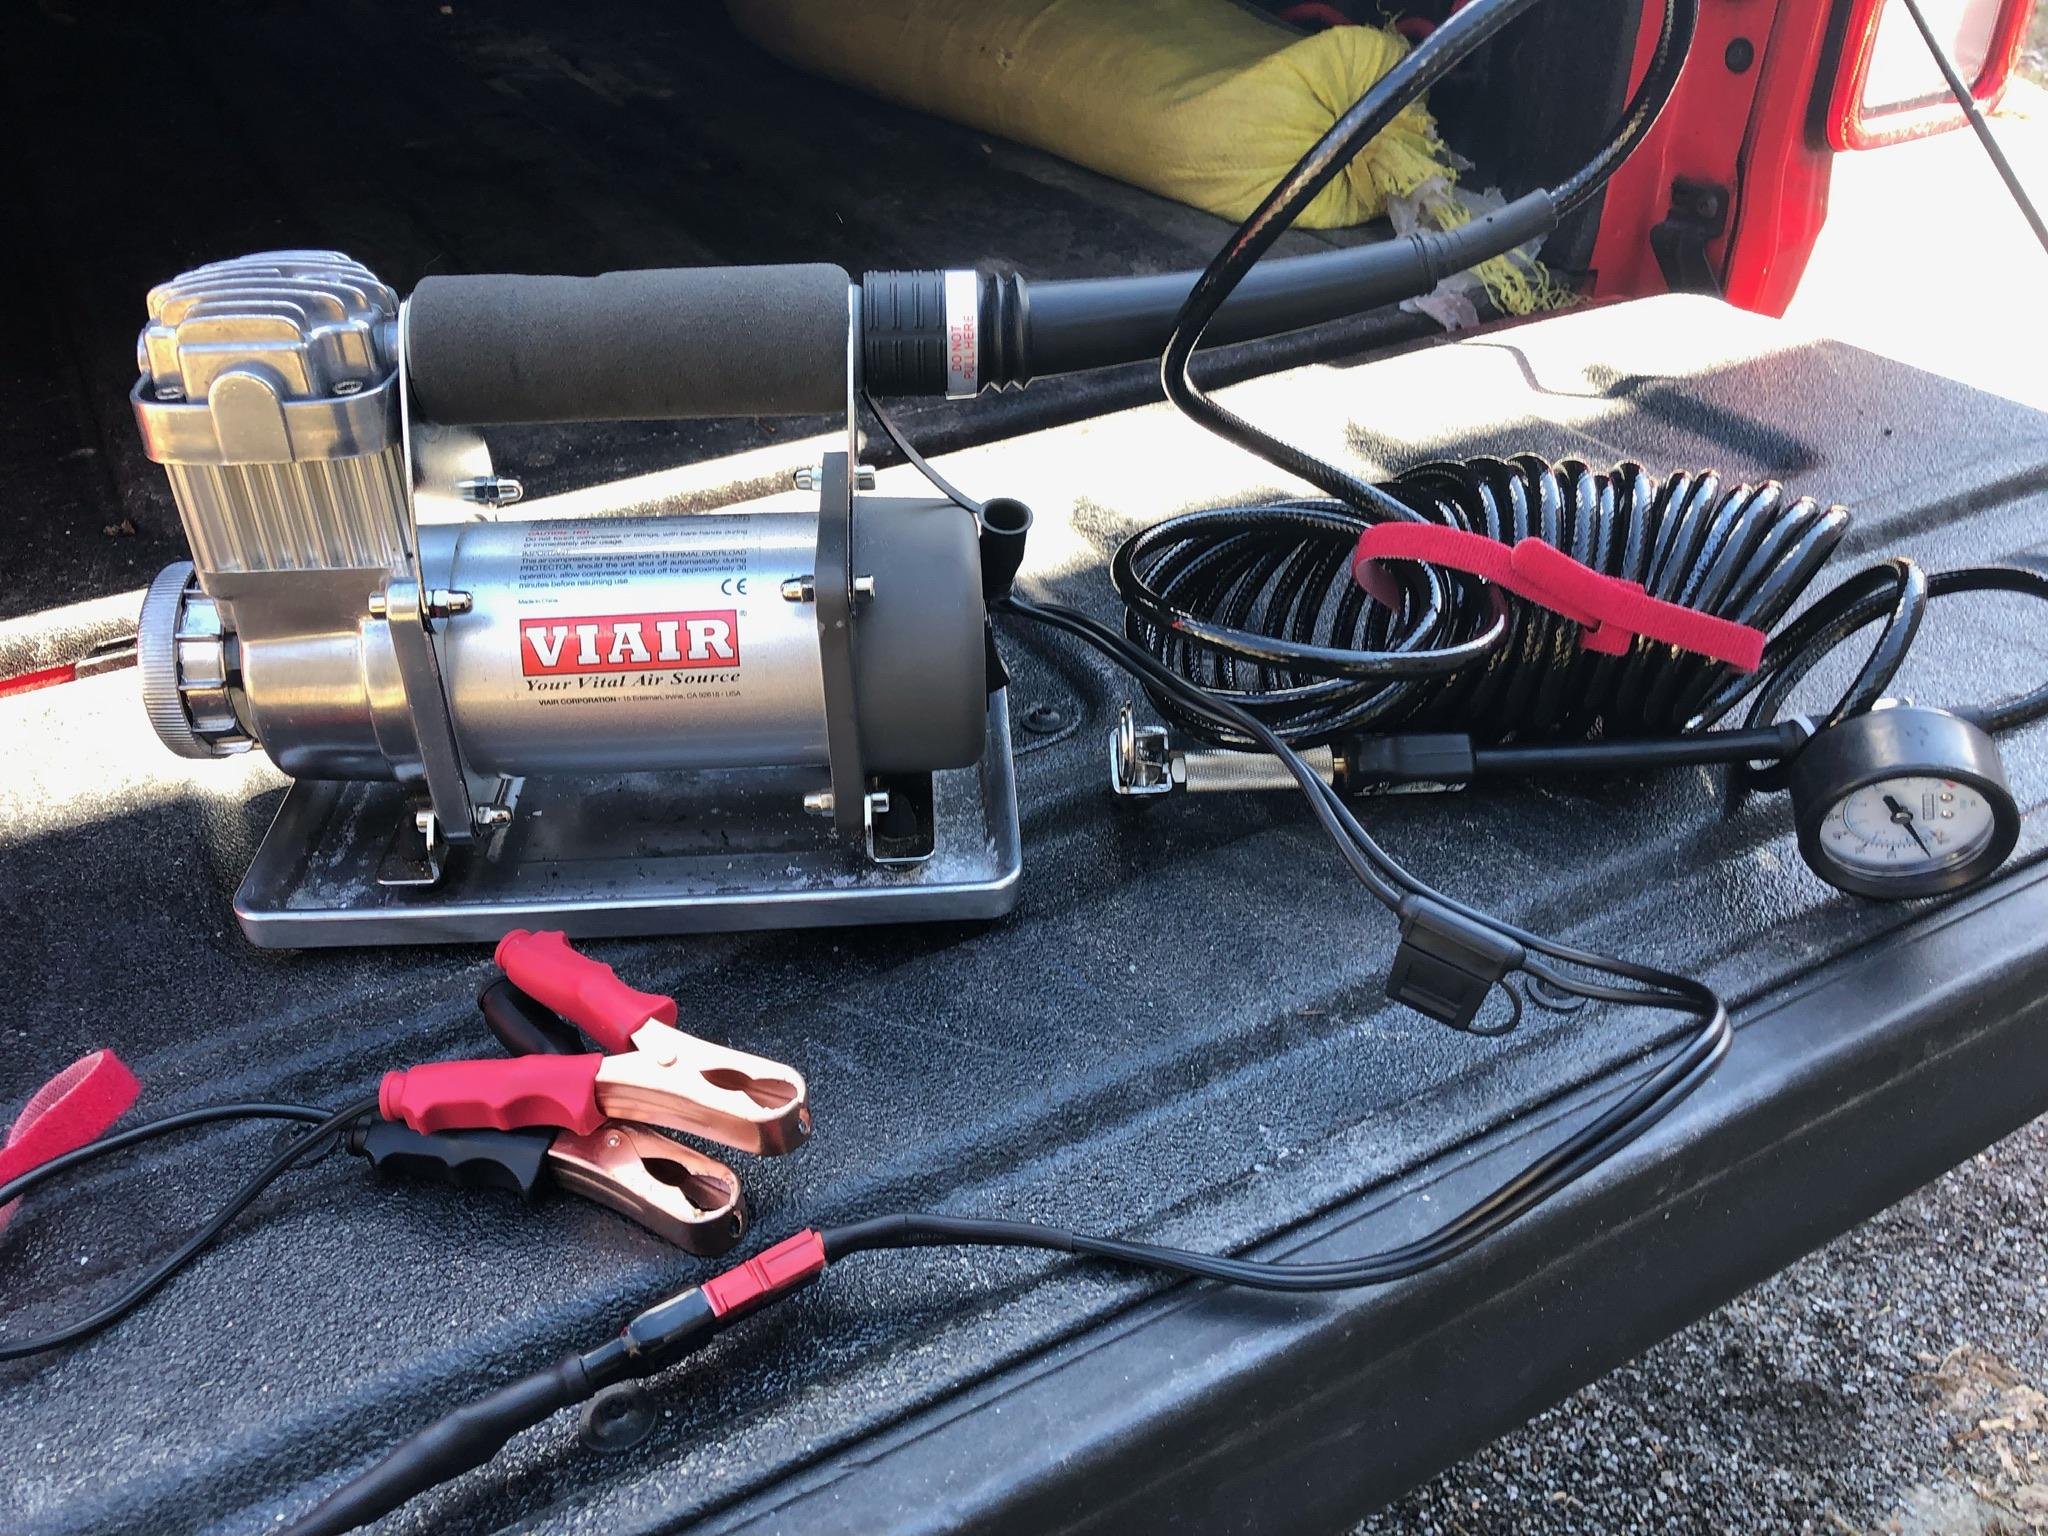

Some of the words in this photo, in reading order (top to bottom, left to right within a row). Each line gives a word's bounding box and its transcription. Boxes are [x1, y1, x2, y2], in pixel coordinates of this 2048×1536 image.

[951, 325, 961, 352] NOT
[964, 316, 974, 349] HERE
[952, 355, 961, 371] DO
[964, 352, 974, 379] PULL
[671, 558, 719, 566] automatically
[721, 578, 747, 596] CE
[525, 620, 736, 668] VIAIR
[526, 679, 571, 691] Your
[579, 675, 625, 688] Vital
[632, 674, 663, 686] Air
[671, 672, 740, 685] Source
